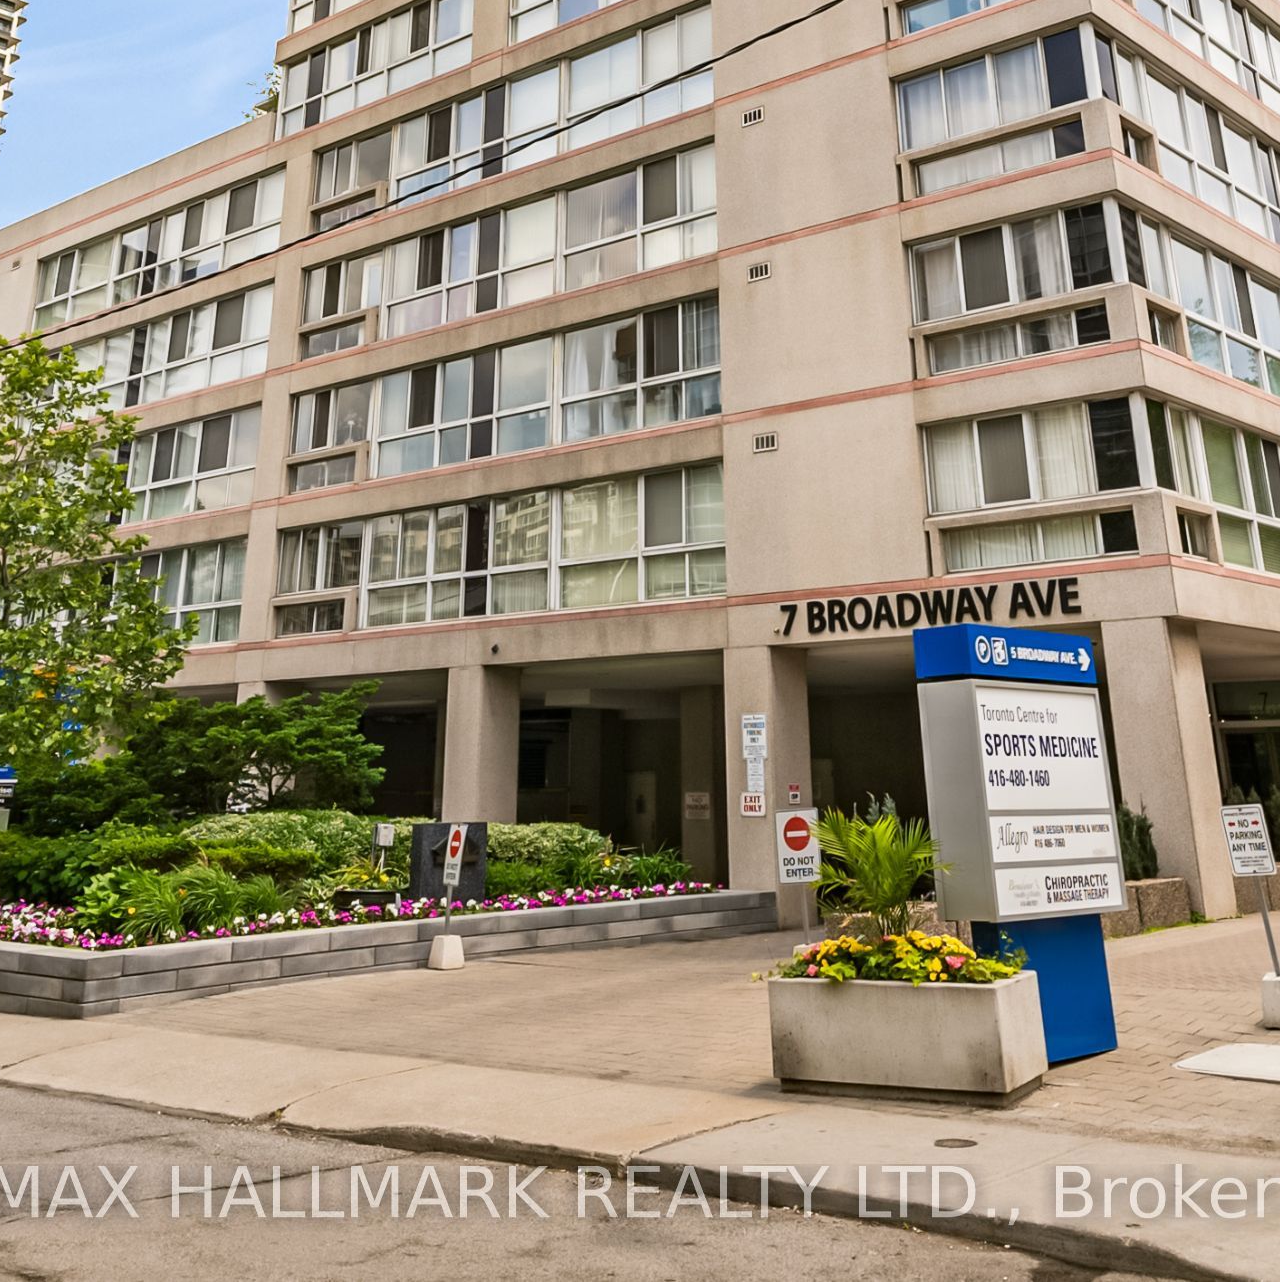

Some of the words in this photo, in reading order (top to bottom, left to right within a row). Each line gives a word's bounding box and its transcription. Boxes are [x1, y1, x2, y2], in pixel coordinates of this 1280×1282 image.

[780, 604, 797, 635] 7
[807, 584, 998, 634] BROADWAY
[1009, 577, 1082, 618] AVE
[1010, 647, 1017, 658] 5
[1017, 647, 1059, 663] BROADWAY
[980, 704, 1014, 721] Toronto
[1017, 706, 1044, 723] Centre
[1046, 708, 1058, 724] for
[985, 733, 1037, 757] SPORTS
[1039, 735, 1099, 758] MEDICINE
[988, 769, 1050, 787] 416-480-1460
[744, 795, 761, 804] EXIT
[743, 804, 762, 812] ONLY
[1032, 825, 1045, 834] HAIR
[1045, 825, 1064, 834] DESIGN
[1065, 825, 1073, 833] FOR
[1074, 824, 1086, 833] MEN
[1091, 824, 1110, 833] WOMEN
[1237, 819, 1249, 828] NO
[997, 823, 1028, 853] Allegro
[1229, 830, 1263, 840] PARKING
[1232, 843, 1246, 852] ANY
[1248, 842, 1267, 851] TIME
[783, 857, 795, 866] DO
[798, 856, 814, 865] NOT
[786, 868, 814, 877] ENTER
[1045, 874, 1109, 890] CHIROPRACTIC
[1047, 892, 1052, 903] &
[1053, 889, 1083, 903] MASSAGE
[1084, 888, 1109, 900] THERAPY
